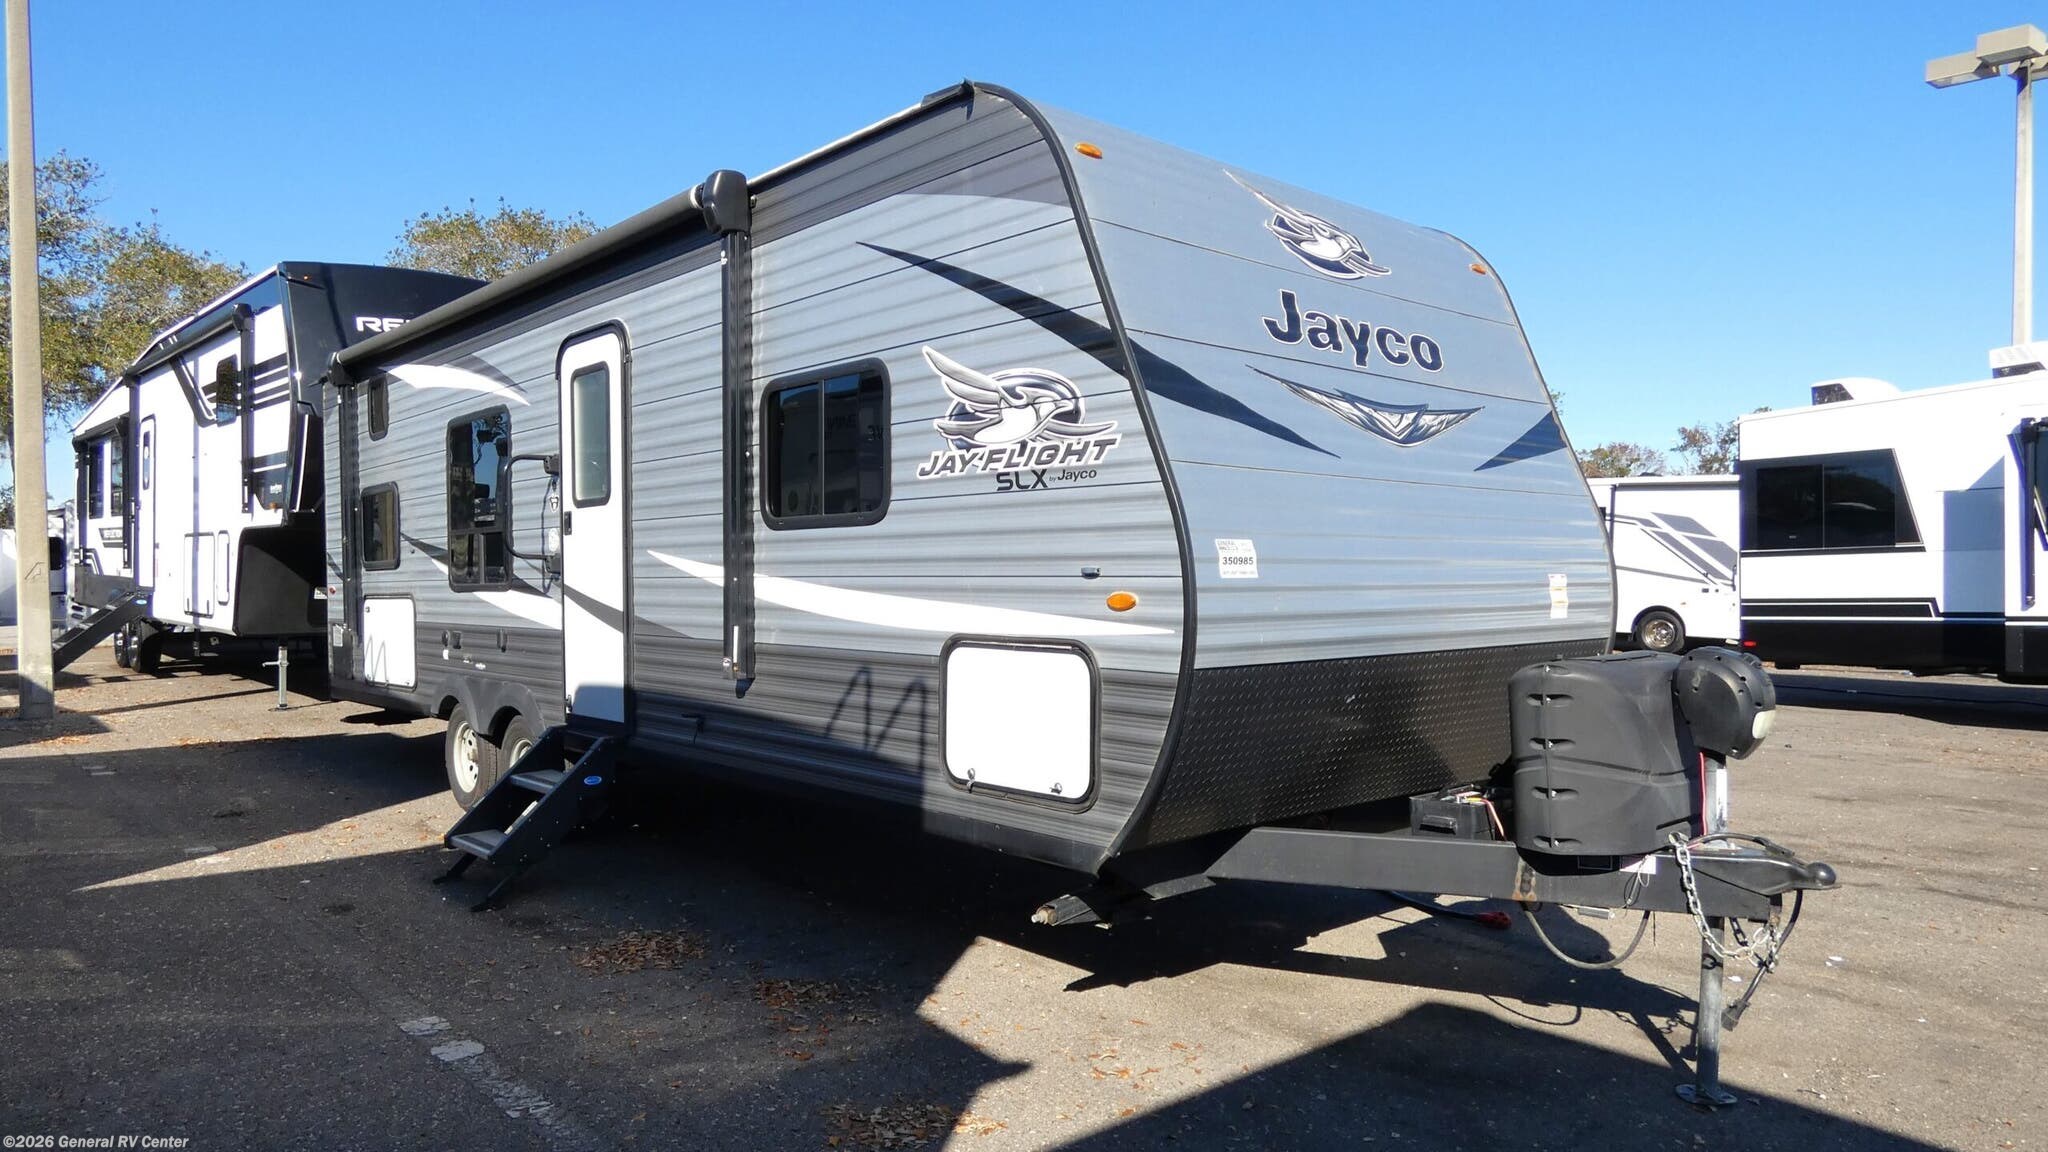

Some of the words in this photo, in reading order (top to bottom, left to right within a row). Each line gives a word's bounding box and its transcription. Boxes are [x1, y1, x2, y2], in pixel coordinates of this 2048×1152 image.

[1262, 289, 1444, 372] Jayco
[918, 451, 979, 477] JAY
[981, 438, 1118, 471] FLIGHT
[996, 468, 1049, 492] SLX
[1057, 468, 1097, 482] Jayco
[1222, 556, 1254, 566] 350985
